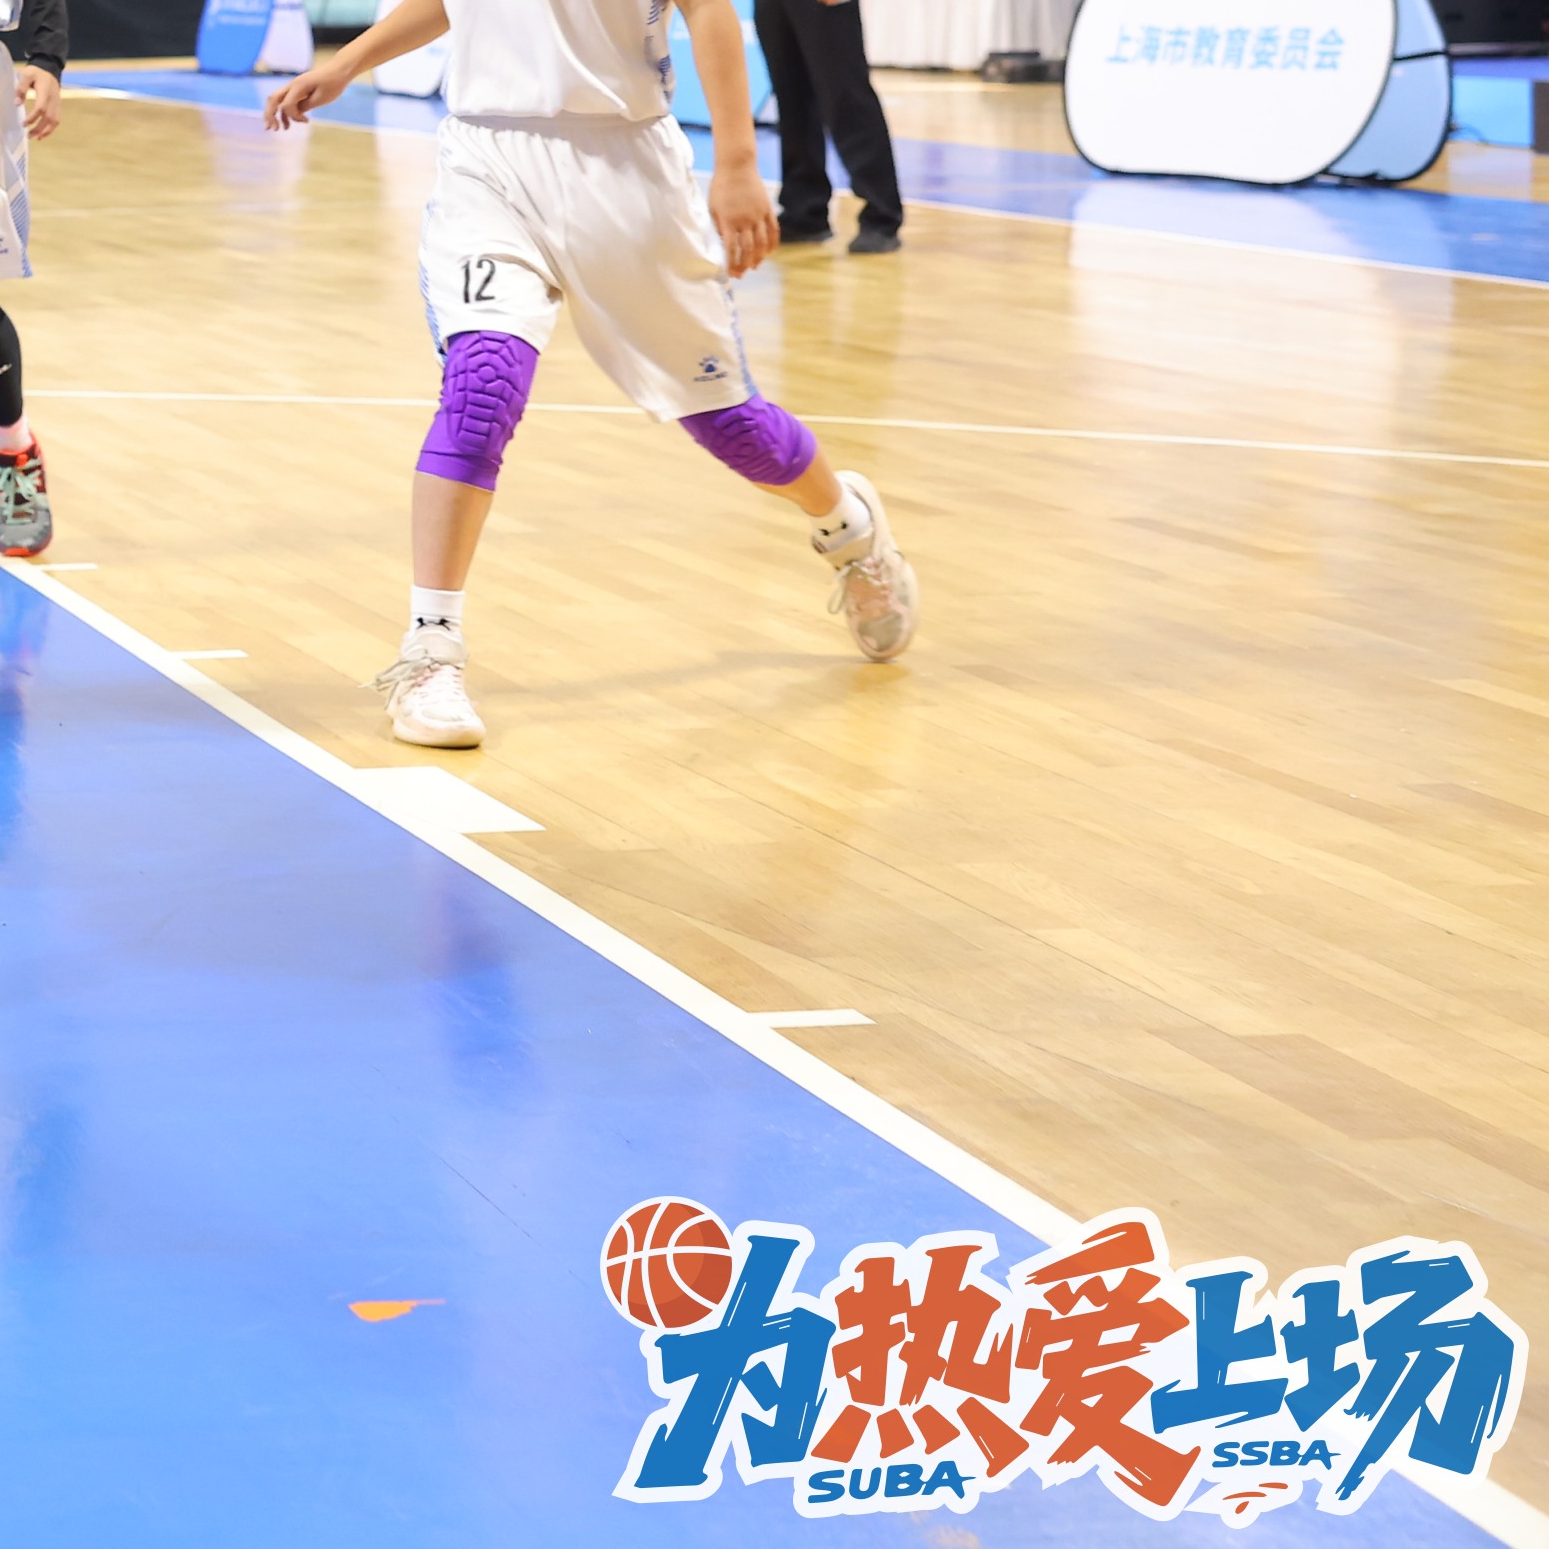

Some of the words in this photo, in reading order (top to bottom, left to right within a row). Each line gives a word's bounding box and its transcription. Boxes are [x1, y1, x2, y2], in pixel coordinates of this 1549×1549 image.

[1105, 25, 1345, 72] 上海市教育委员会
[460, 259, 496, 304] 12
